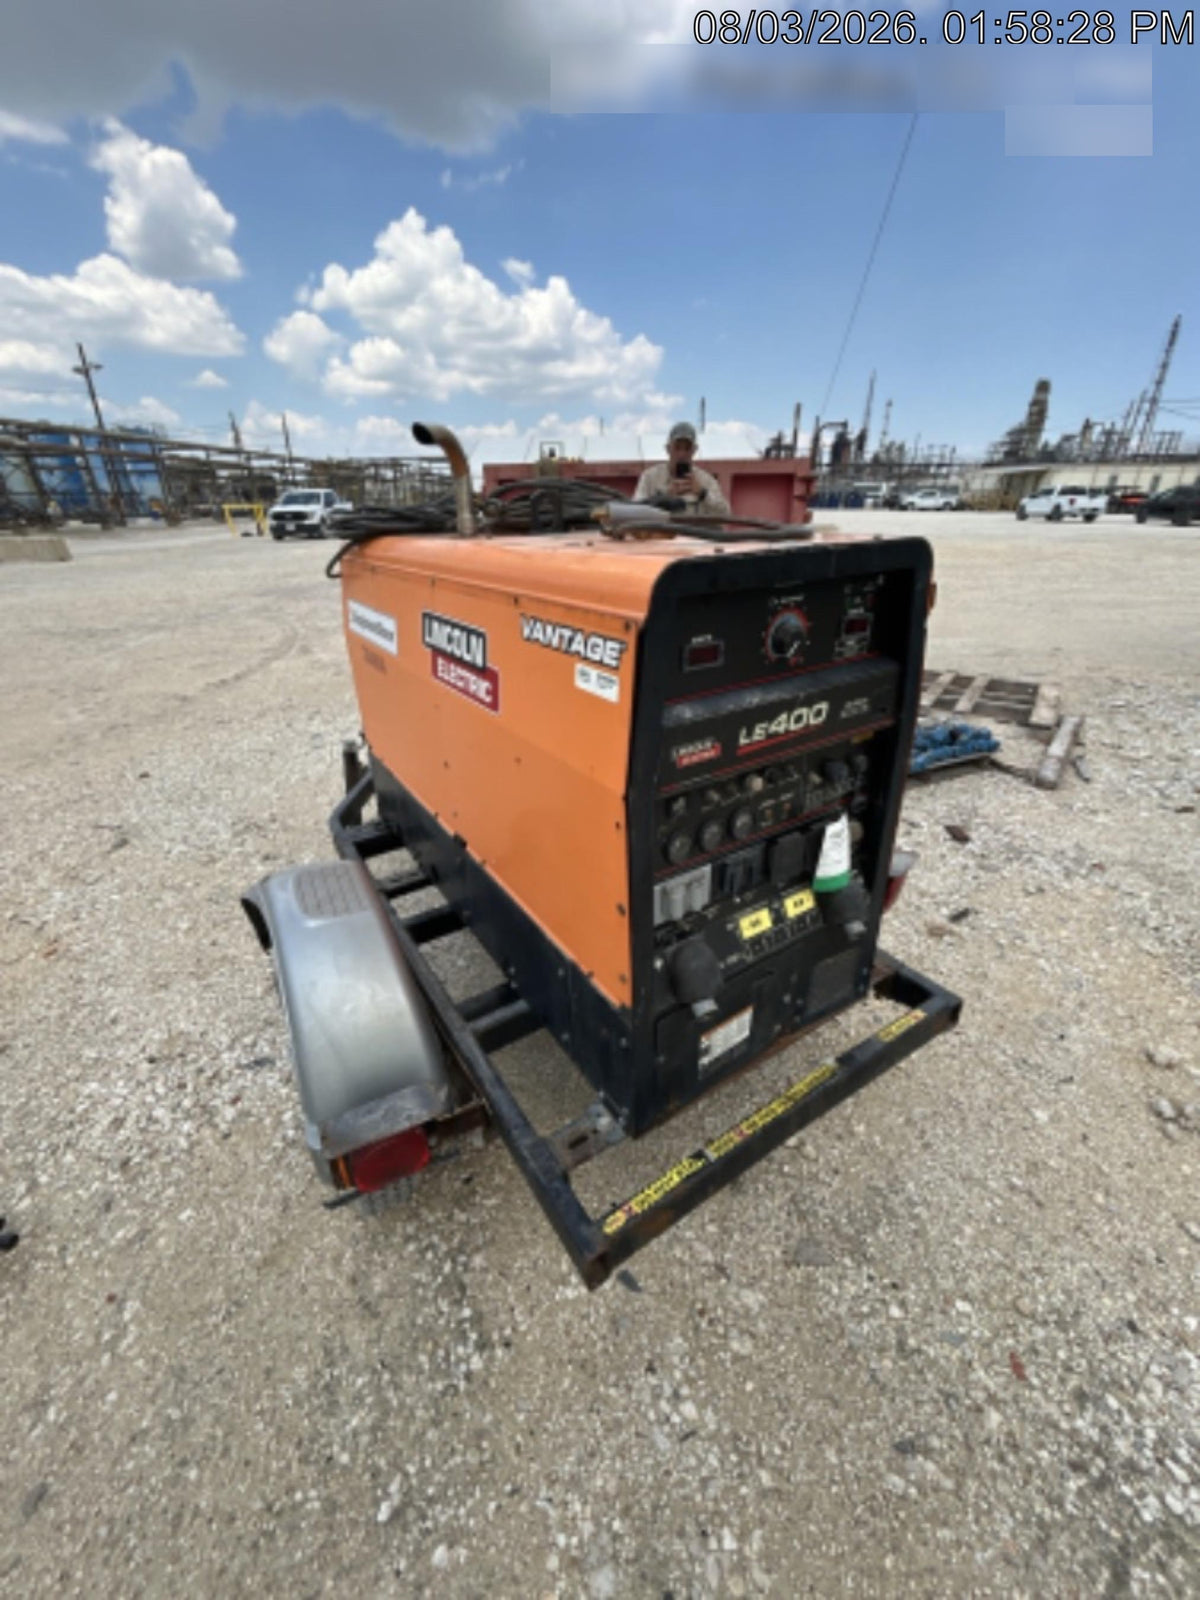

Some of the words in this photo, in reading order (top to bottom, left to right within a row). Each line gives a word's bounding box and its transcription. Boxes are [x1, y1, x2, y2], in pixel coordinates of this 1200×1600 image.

[424, 616, 485, 669] LINCOLN
[520, 614, 624, 669] VANTAGE
[436, 655, 494, 704] ELECTRIC
